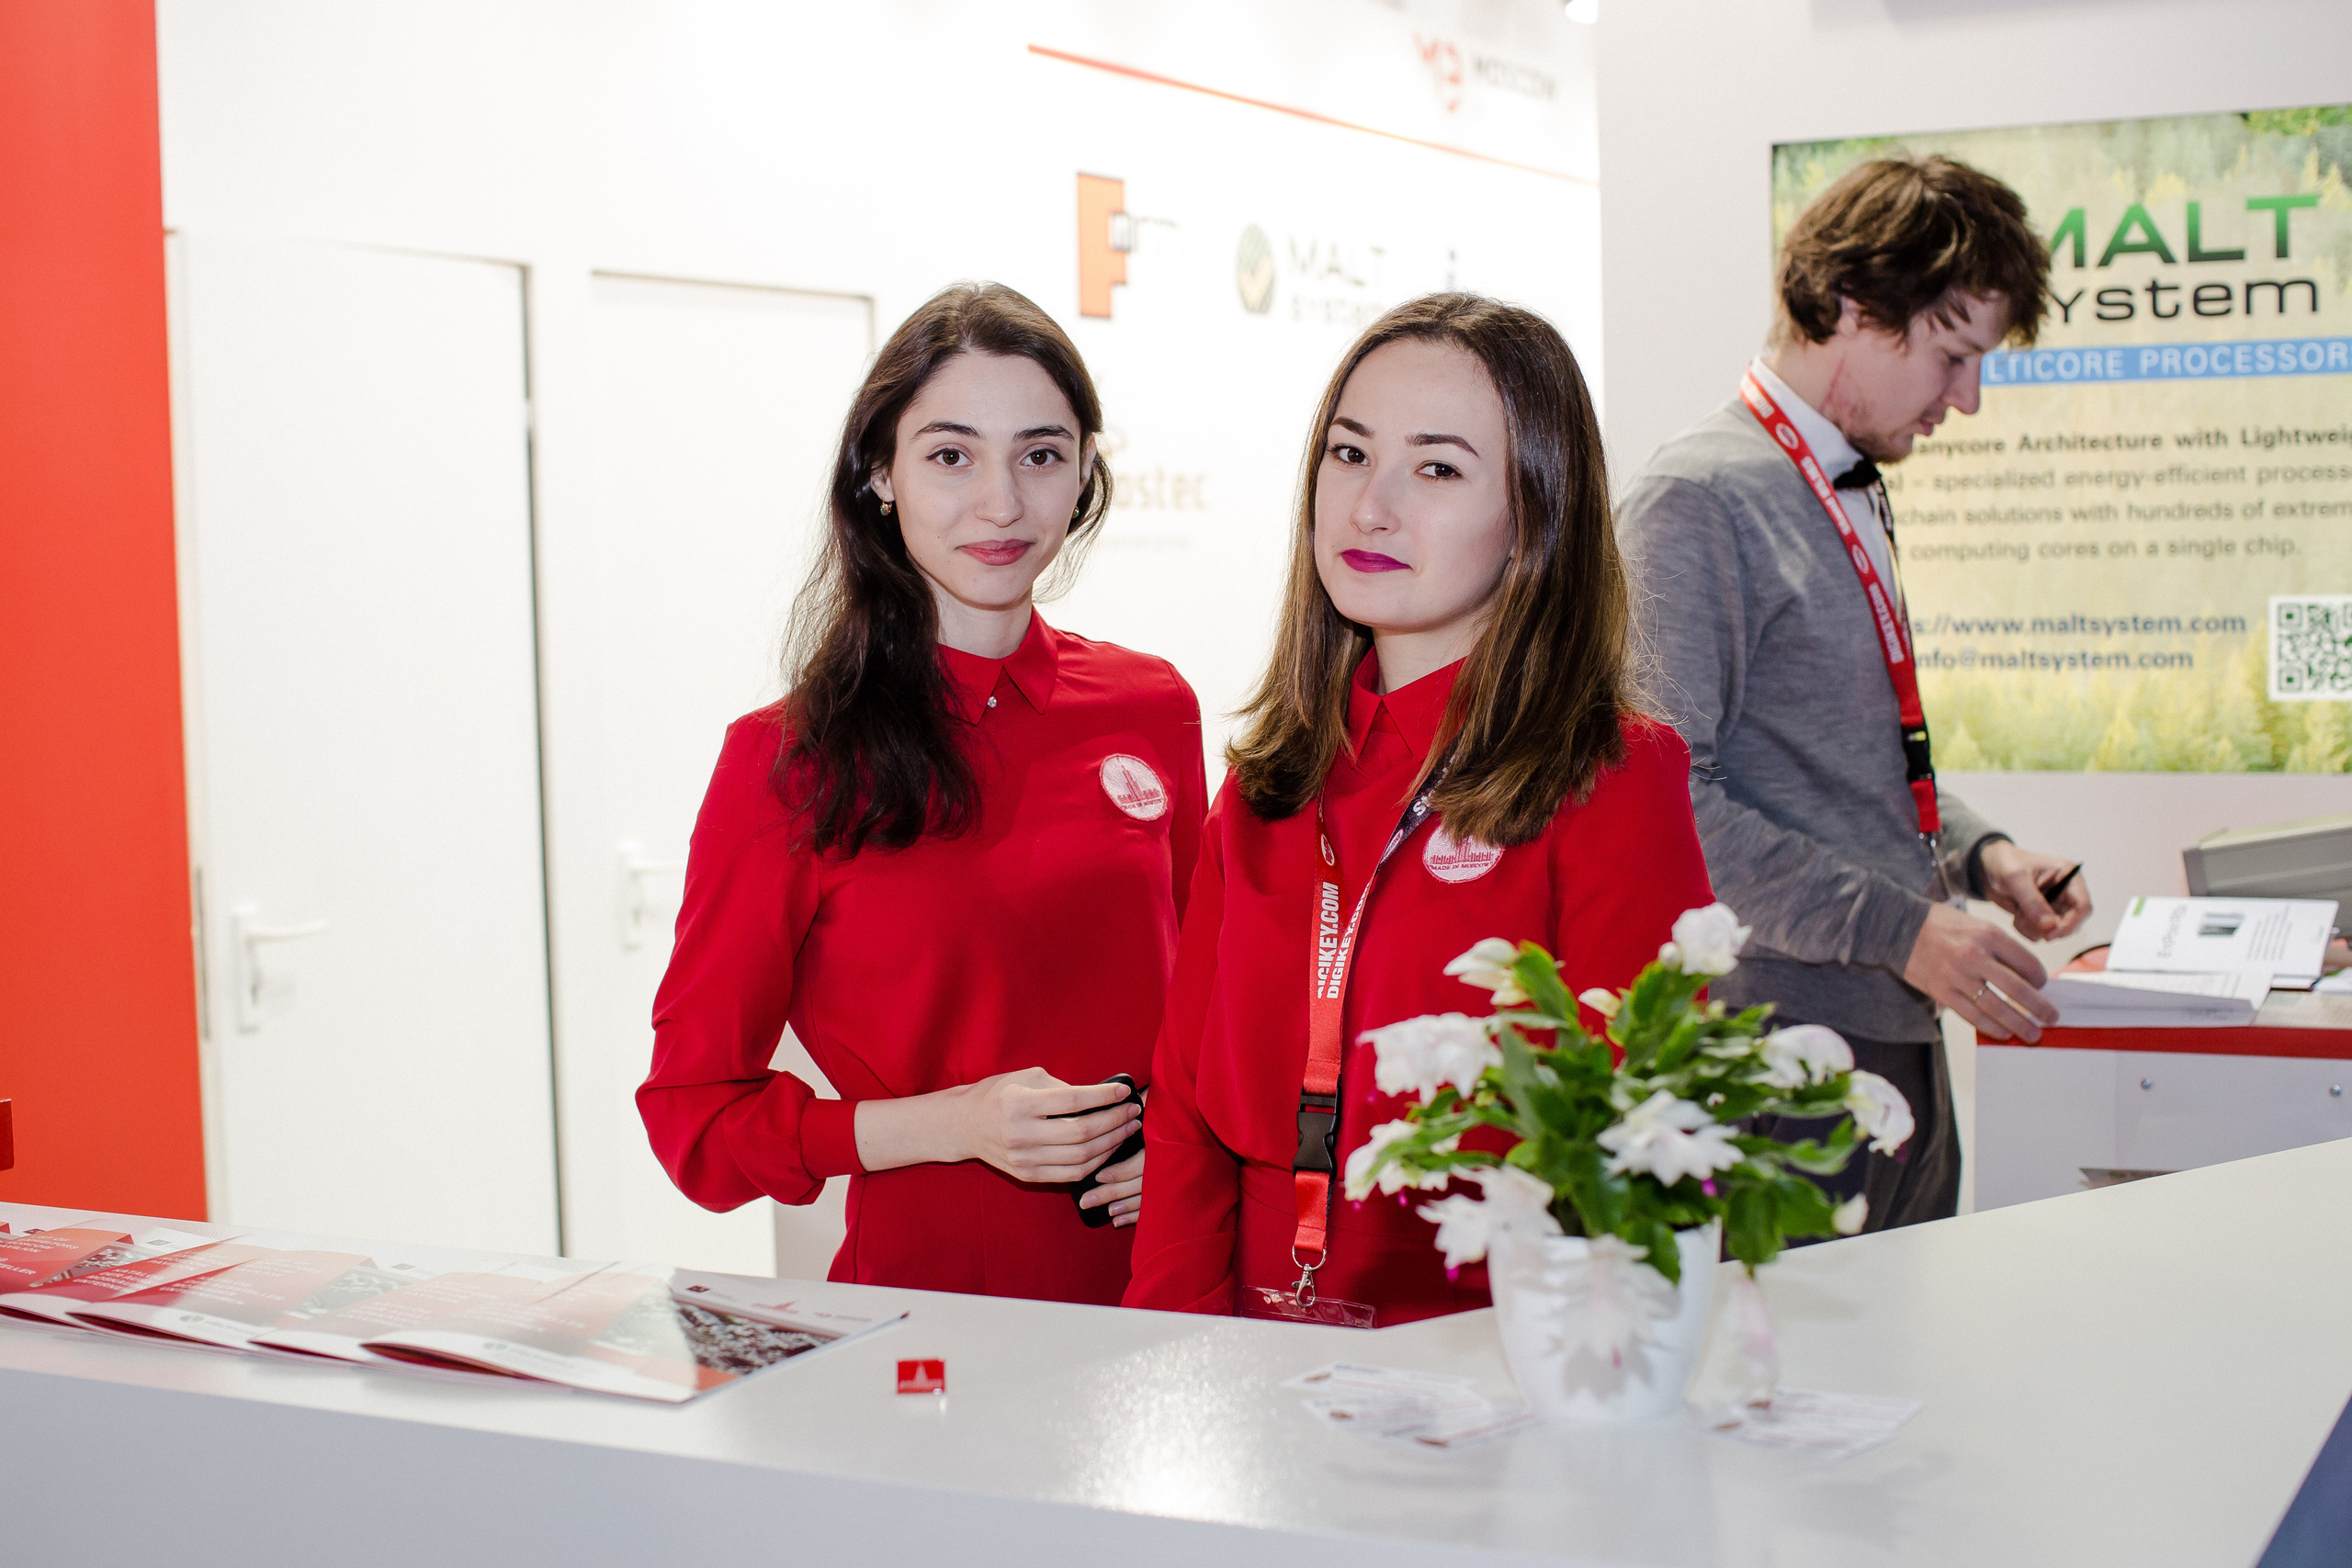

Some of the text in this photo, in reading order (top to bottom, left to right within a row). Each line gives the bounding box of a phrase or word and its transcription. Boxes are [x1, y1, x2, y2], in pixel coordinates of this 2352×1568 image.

[1985, 341, 2352, 383] LTICORE PROCESSOR
[1913, 439, 2006, 459] anycore
[2018, 432, 2163, 453] Architecture
[2175, 426, 2229, 450] with
[1933, 469, 2056, 492] specialized
[1964, 503, 2063, 526] solutions
[2069, 501, 2119, 523] with
[2126, 499, 2234, 523] hundreds
[2242, 496, 2265, 520] of
[1910, 539, 2030, 564] computing
[2038, 539, 2100, 558] cores
[2109, 539, 2138, 557] on
[2146, 538, 2160, 556] a
[2166, 535, 2237, 562] single
[1914, 612, 2247, 639] s://www.maltsystem.com
[1916, 646, 2194, 675] nfo@maltsystem.com
